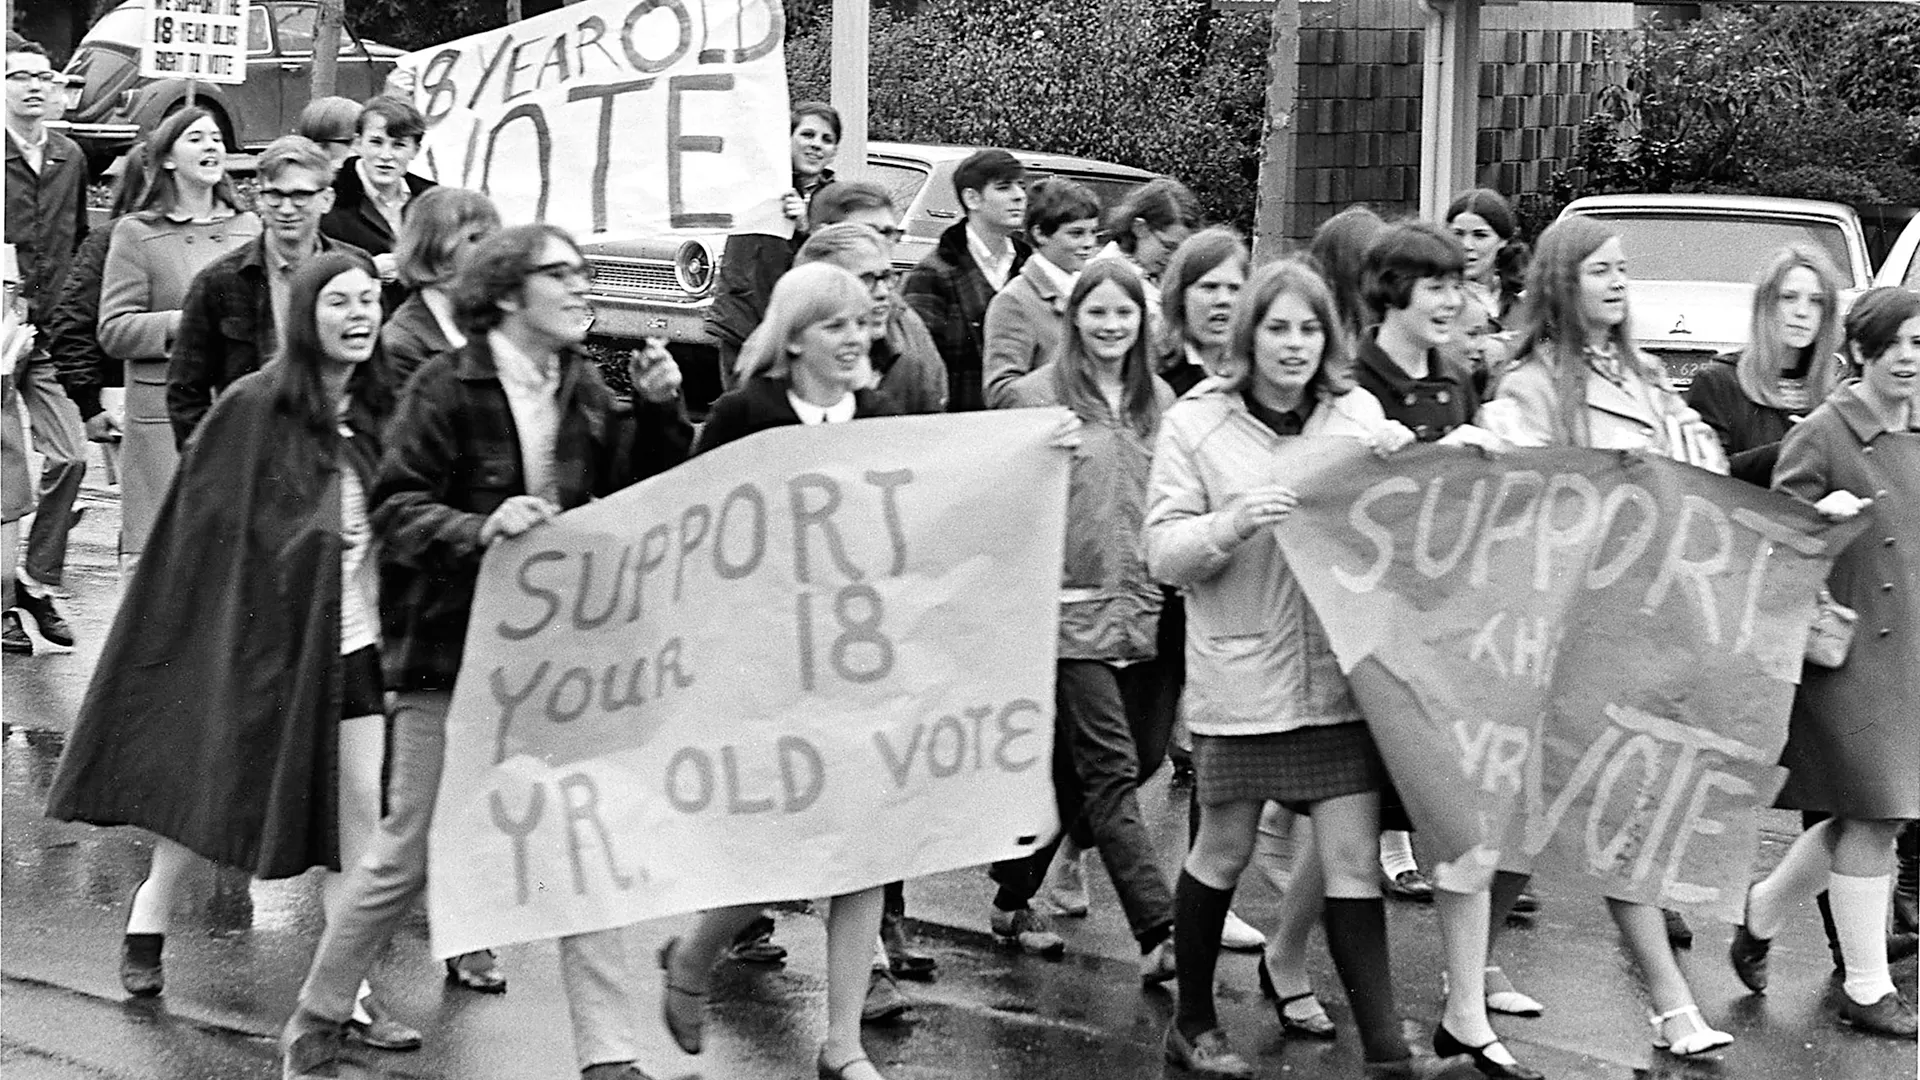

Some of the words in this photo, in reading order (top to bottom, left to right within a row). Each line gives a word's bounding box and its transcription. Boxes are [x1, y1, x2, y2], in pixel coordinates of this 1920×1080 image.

[468, 15, 624, 110] YEAR
[620, 0, 784, 74] OLD
[497, 467, 915, 641] SUPPORT
[1331, 470, 1828, 655] SUPPORT
[489, 637, 696, 766] YOUR
[799, 583, 895, 692] 18
[664, 735, 826, 814] OLD
[872, 698, 1043, 790] VOTE
[1453, 720, 1530, 793] YR
[1520, 702, 1768, 904] VOTE
